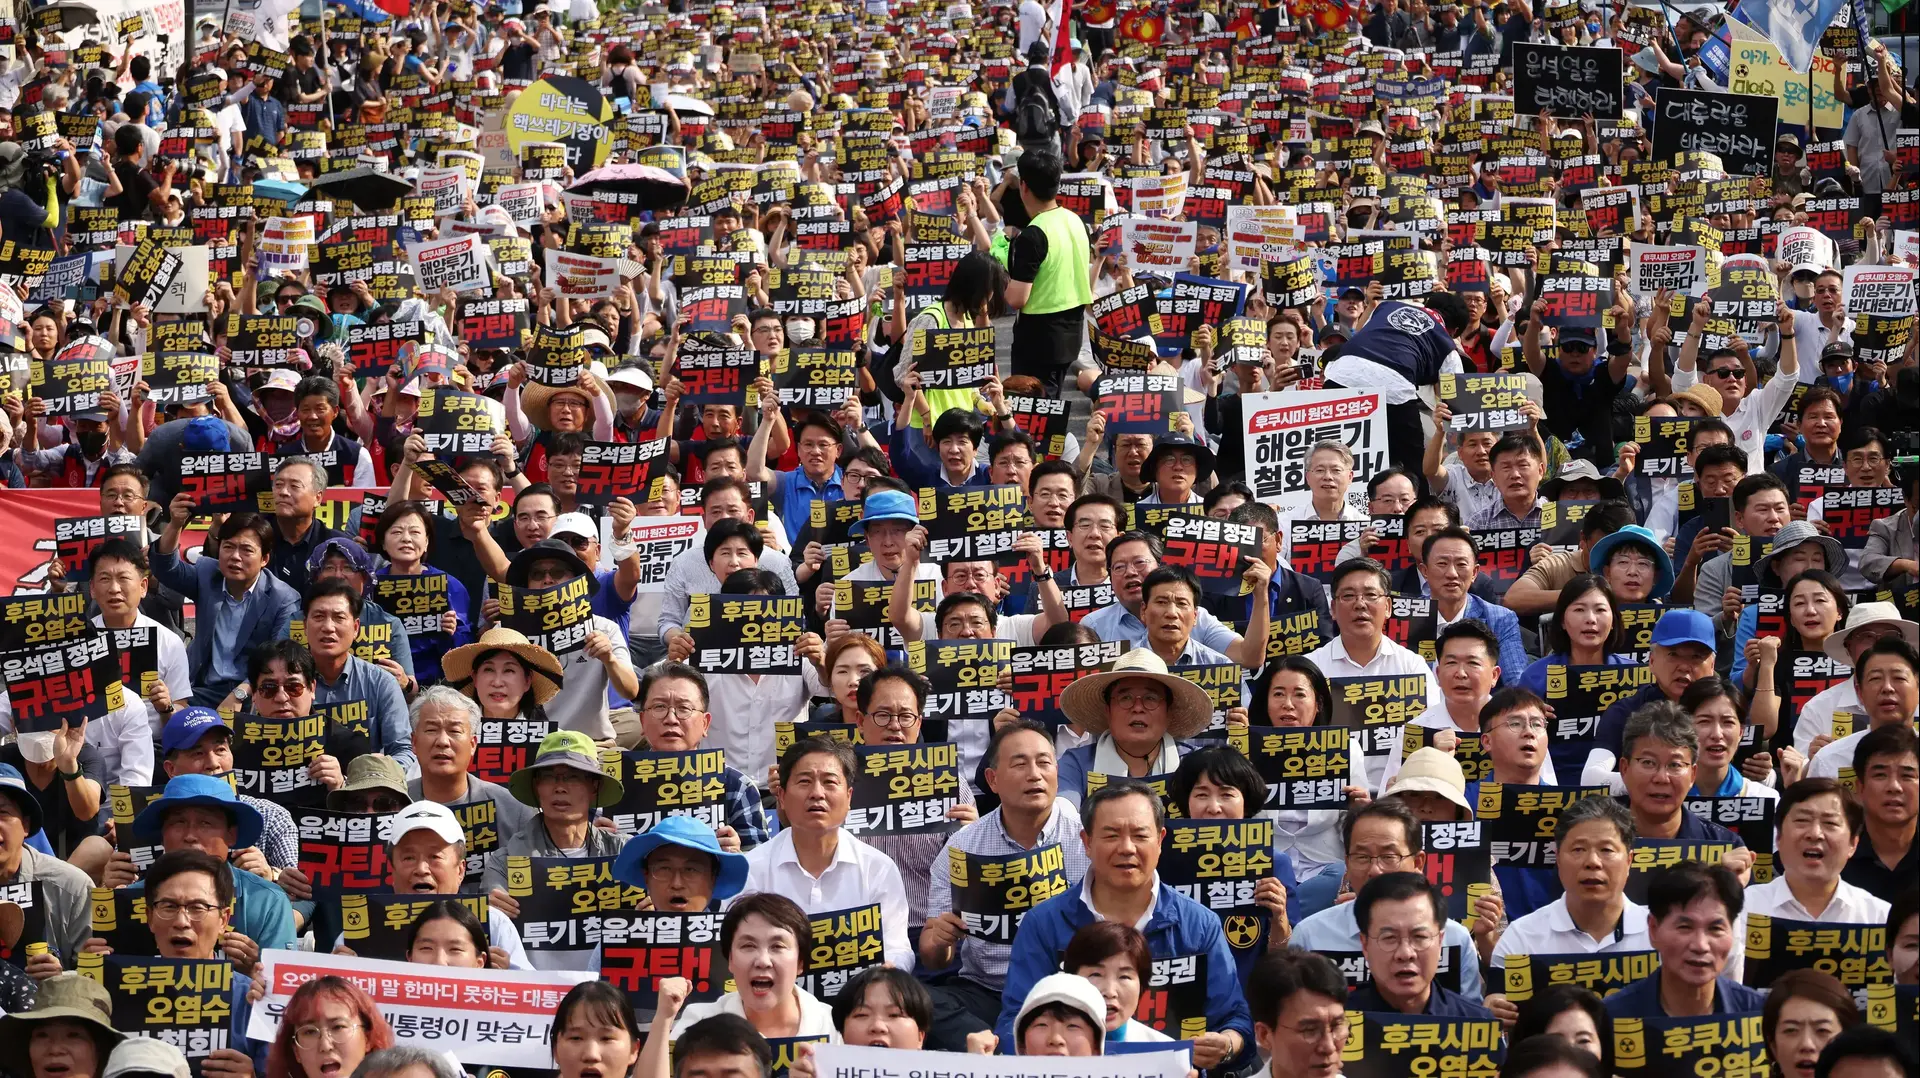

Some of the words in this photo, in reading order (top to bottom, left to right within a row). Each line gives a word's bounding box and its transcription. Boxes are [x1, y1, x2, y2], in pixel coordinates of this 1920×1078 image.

[1526, 51, 1599, 82] 윤석열을
[540, 92, 588, 115] 바다는
[1534, 87, 1617, 115] 탄핵하라
[1665, 99, 1748, 127] 대통령을
[512, 113, 609, 145] 핵쓰레기장이
[762, 123, 793, 136] 규탄!
[852, 149, 887, 162] 후쿠시마
[1806, 143, 1830, 154] 윤석열
[542, 155, 564, 167] 오염수
[861, 160, 886, 170] 오염수
[1388, 152, 1423, 168] 규탄!
[1435, 157, 1468, 166] 후쿠시마
[1808, 153, 1840, 168] 규탄!
[526, 169, 542, 181] 투기
[220, 186, 253, 197] 후쿠시마
[227, 196, 253, 206] 오염수
[592, 192, 614, 202] 윤석열
[619, 194, 637, 204] 정권
[916, 190, 950, 210] 규탄!
[1188, 187, 1212, 198] 윤석열
[1213, 188, 1231, 199] 정권
[1584, 194, 1605, 209] 윤석열
[193, 208, 216, 219] 윤석열
[593, 202, 626, 220] 규탄!
[1184, 199, 1224, 217] 규탄!
[1806, 200, 1836, 211] 윤석열
[195, 220, 228, 236] 규탄!
[660, 228, 700, 247] 규탄!
[327, 243, 372, 258] 후쿠시마
[799, 234, 839, 250] 규탄!
[124, 238, 156, 283] 후쿠시마
[141, 246, 164, 283] 오염수
[336, 254, 372, 269] 오염수
[420, 252, 475, 276] 해양투기
[905, 246, 943, 261] 윤석열
[1645, 253, 1665, 261] 후쿠시마
[345, 268, 372, 284] 철회!
[1275, 257, 1310, 279] 후쿠시마
[1337, 257, 1373, 278] 규탄!
[1639, 264, 1695, 278] 해양투기
[424, 267, 481, 292] 반대한다!
[1640, 275, 1699, 293] 반대한다!
[170, 281, 187, 305] 핵
[682, 289, 719, 305] 윤석열
[1093, 296, 1122, 317] 윤석열
[1123, 284, 1148, 303] 정권
[1175, 284, 1211, 299] 윤석열
[1851, 283, 1905, 300] 해양투기
[1543, 293, 1596, 316] 규탄!
[1713, 301, 1744, 316] 투기
[1850, 297, 1913, 314] 반대한다!
[157, 322, 203, 338] 후쿠시마
[464, 314, 514, 338] 규탄!
[1099, 306, 1142, 335] 규탄!
[1878, 318, 1913, 335] 후쿠시마
[258, 331, 296, 346] 오염수
[539, 331, 584, 352] 후쿠시마
[935, 330, 994, 351] 후쿠시마
[1887, 332, 1909, 346] 오염수
[164, 356, 218, 372] 후쿠시마
[232, 350, 258, 365] 투기
[547, 346, 584, 365] 오염수
[680, 353, 722, 368] 윤석열
[726, 350, 754, 365] 정권
[797, 352, 856, 368] 후쿠시마
[1859, 348, 1884, 362] 투기
[682, 369, 738, 394] 규탄!
[1467, 377, 1526, 395] 후쿠시마
[1099, 394, 1160, 422] 규탄!
[1482, 393, 1526, 408] 오염수
[1308, 405, 1333, 421] 원전
[1451, 414, 1484, 431] 투기
[639, 437, 666, 460] 정권
[1256, 419, 1371, 466] 해양투기
[181, 455, 224, 475] 윤석열
[1254, 451, 1384, 499] 철회라!
[579, 464, 647, 495] 규탄!
[948, 487, 1022, 514] 후쿠시마
[1825, 490, 1872, 507] 윤석열
[967, 508, 1022, 531] 오염수
[1167, 518, 1219, 540] 윤석열
[650, 527, 668, 541] 원전
[1292, 523, 1340, 542] 윤석열
[930, 540, 970, 566] 투기
[380, 577, 446, 600] 후쿠시마
[524, 578, 590, 612] 후쿠시마
[5, 596, 85, 628] 후쿠시마
[542, 601, 591, 629] 오염수
[722, 600, 802, 628] 후쿠시마
[1393, 599, 1431, 616] 정권
[26, 616, 85, 642] 오염수
[115, 627, 149, 648] 정권
[741, 616, 801, 643] 오염수
[938, 643, 1012, 668] 후쿠시마
[1012, 649, 1074, 672] 윤석열
[1080, 640, 1121, 667] 정권
[1268, 636, 1320, 657] 오염수
[4, 651, 64, 680] 윤석열
[67, 639, 108, 666] 정권
[700, 648, 743, 675] 투기
[749, 645, 799, 668] 철회!
[11, 670, 95, 718] 규탄!
[1344, 678, 1425, 707] 후쿠시마
[243, 717, 325, 749] 후쿠시마
[507, 722, 549, 744] 정권
[1262, 729, 1349, 759] 후쿠시마
[634, 756, 725, 788] 후쿠시마
[1283, 757, 1347, 778] 오염수
[657, 780, 724, 805] 오염수
[1718, 799, 1764, 823] 정권
[299, 817, 371, 841] 윤석열
[377, 814, 396, 842] 정
[1172, 827, 1272, 861] 후쿠시마
[981, 850, 1066, 894] 후쿠시마
[1197, 849, 1271, 877] 오염수
[572, 886, 645, 913] 오염수
[521, 920, 576, 951] 투기
[602, 917, 681, 944] 윤석열
[811, 912, 881, 946] 쿠시마
[1789, 929, 1885, 953] 후쿠시마
[810, 940, 882, 970] 오염수
[602, 947, 711, 992] 규탄!
[1550, 954, 1659, 991] 후쿠시마
[1817, 958, 1893, 987] 오염수
[120, 964, 232, 999] 후쿠시마
[381, 979, 401, 997] 말
[404, 980, 459, 1003] 한마디
[463, 984, 519, 1009] 못하는
[522, 988, 567, 1011] 대통
[146, 996, 230, 1023] 오염수
[1381, 1023, 1500, 1058] 후쿠시마
[1411, 1055, 1497, 1078] 오염수
